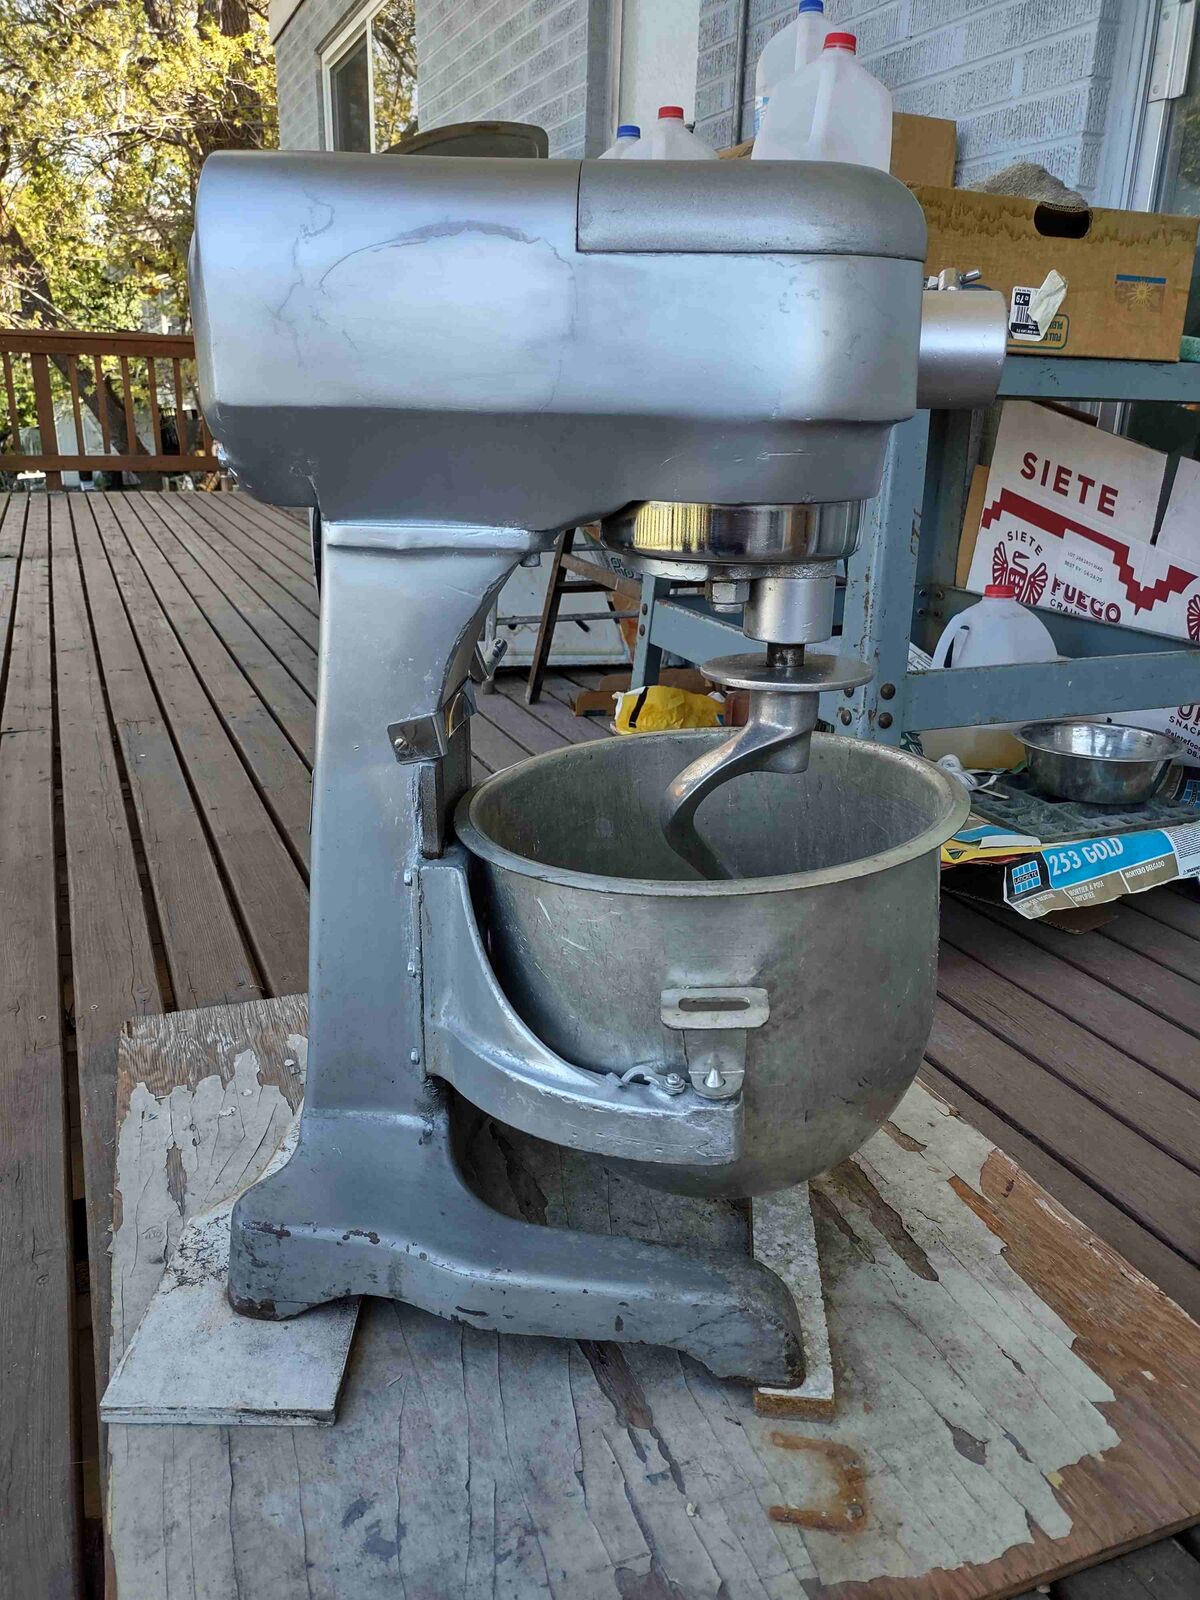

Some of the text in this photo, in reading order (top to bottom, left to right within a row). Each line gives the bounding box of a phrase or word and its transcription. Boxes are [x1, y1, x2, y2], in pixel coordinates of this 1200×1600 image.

[1020, 452, 1119, 517] SIETE
[1007, 530, 1043, 557] SIETE
[1050, 573, 1121, 624] FUEGO
[1049, 837, 1124, 876] 253 GOLD
